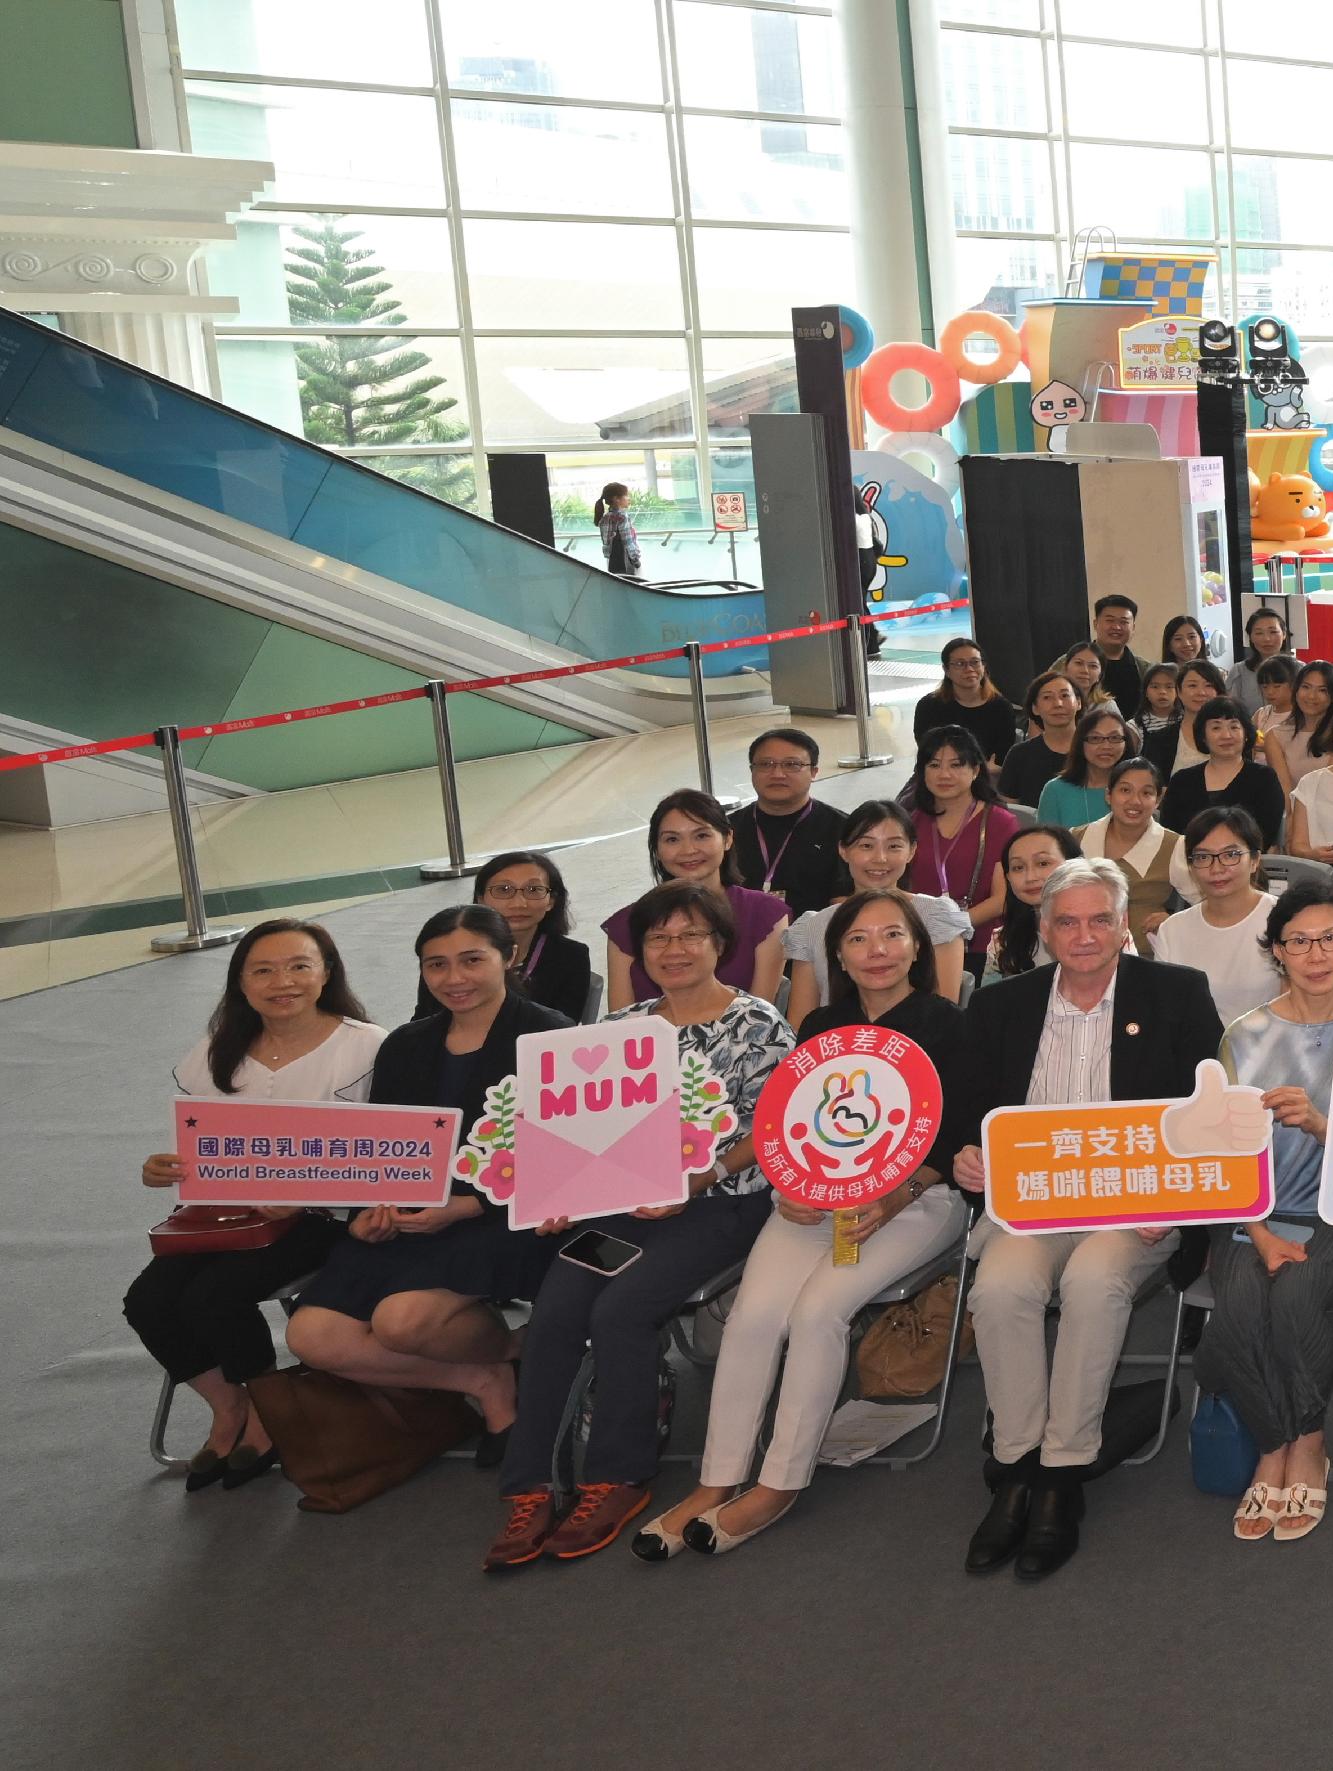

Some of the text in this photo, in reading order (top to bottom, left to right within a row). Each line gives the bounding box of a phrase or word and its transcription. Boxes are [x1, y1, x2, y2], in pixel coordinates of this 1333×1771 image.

[1125, 365, 1201, 381] 萌爆健兒
[541, 1036, 655, 1084] I U
[786, 1028, 912, 1078] 消除差距
[540, 1072, 658, 1120] MUM
[760, 1115, 933, 1201] 為所有人提供母乳哺育支持
[1014, 1124, 1156, 1159] 一齊支持
[198, 1165, 432, 1182] World Breastfeeding Week
[1016, 1161, 1231, 1202] 媽咪餵哺母乳
